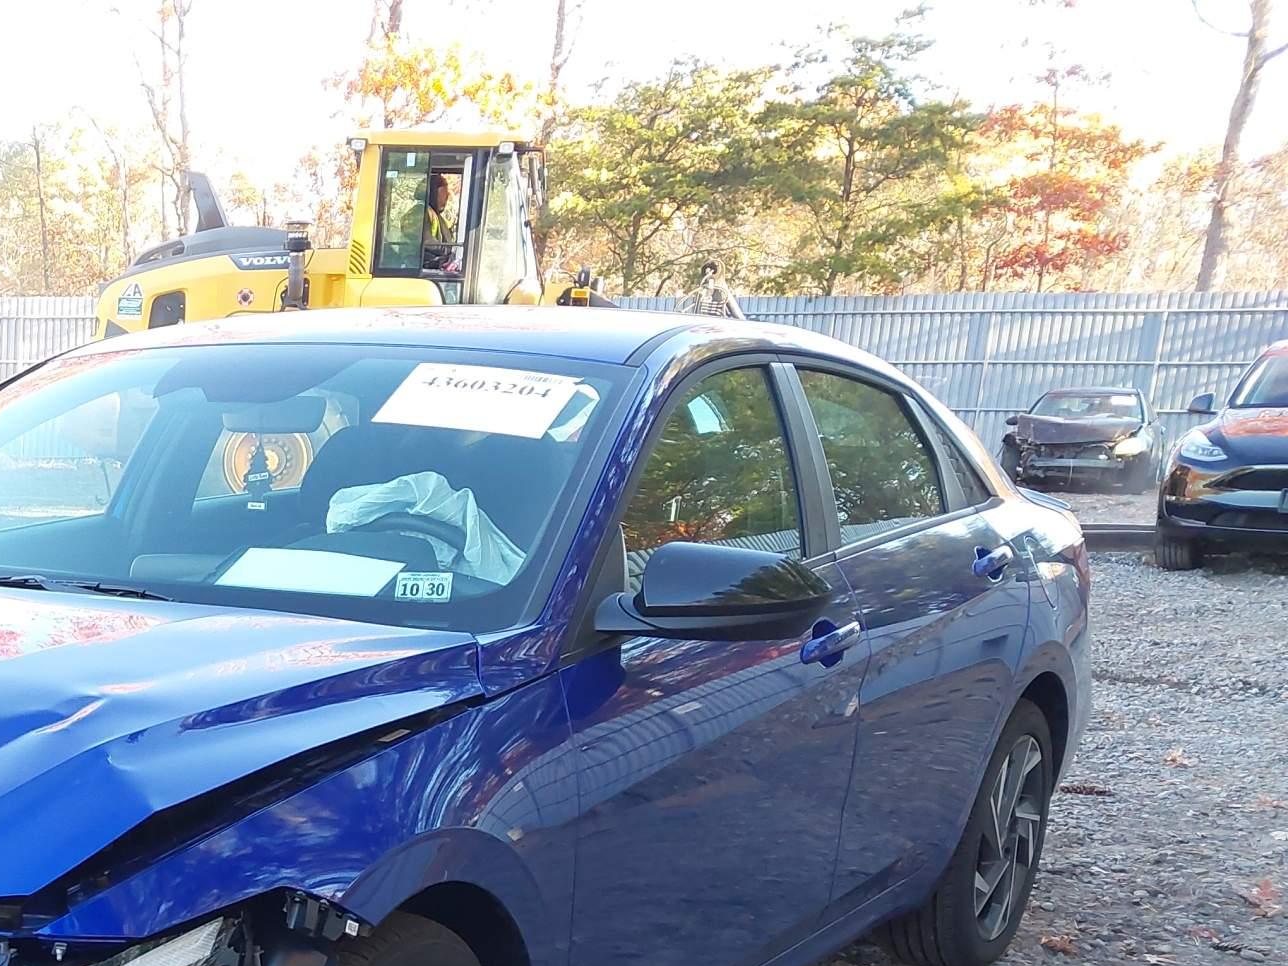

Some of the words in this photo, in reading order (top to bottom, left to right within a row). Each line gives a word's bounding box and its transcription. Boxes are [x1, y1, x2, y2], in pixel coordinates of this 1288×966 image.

[422, 375, 553, 398] 43603204
[399, 582, 421, 597] 10
[425, 582, 446, 597] 30
